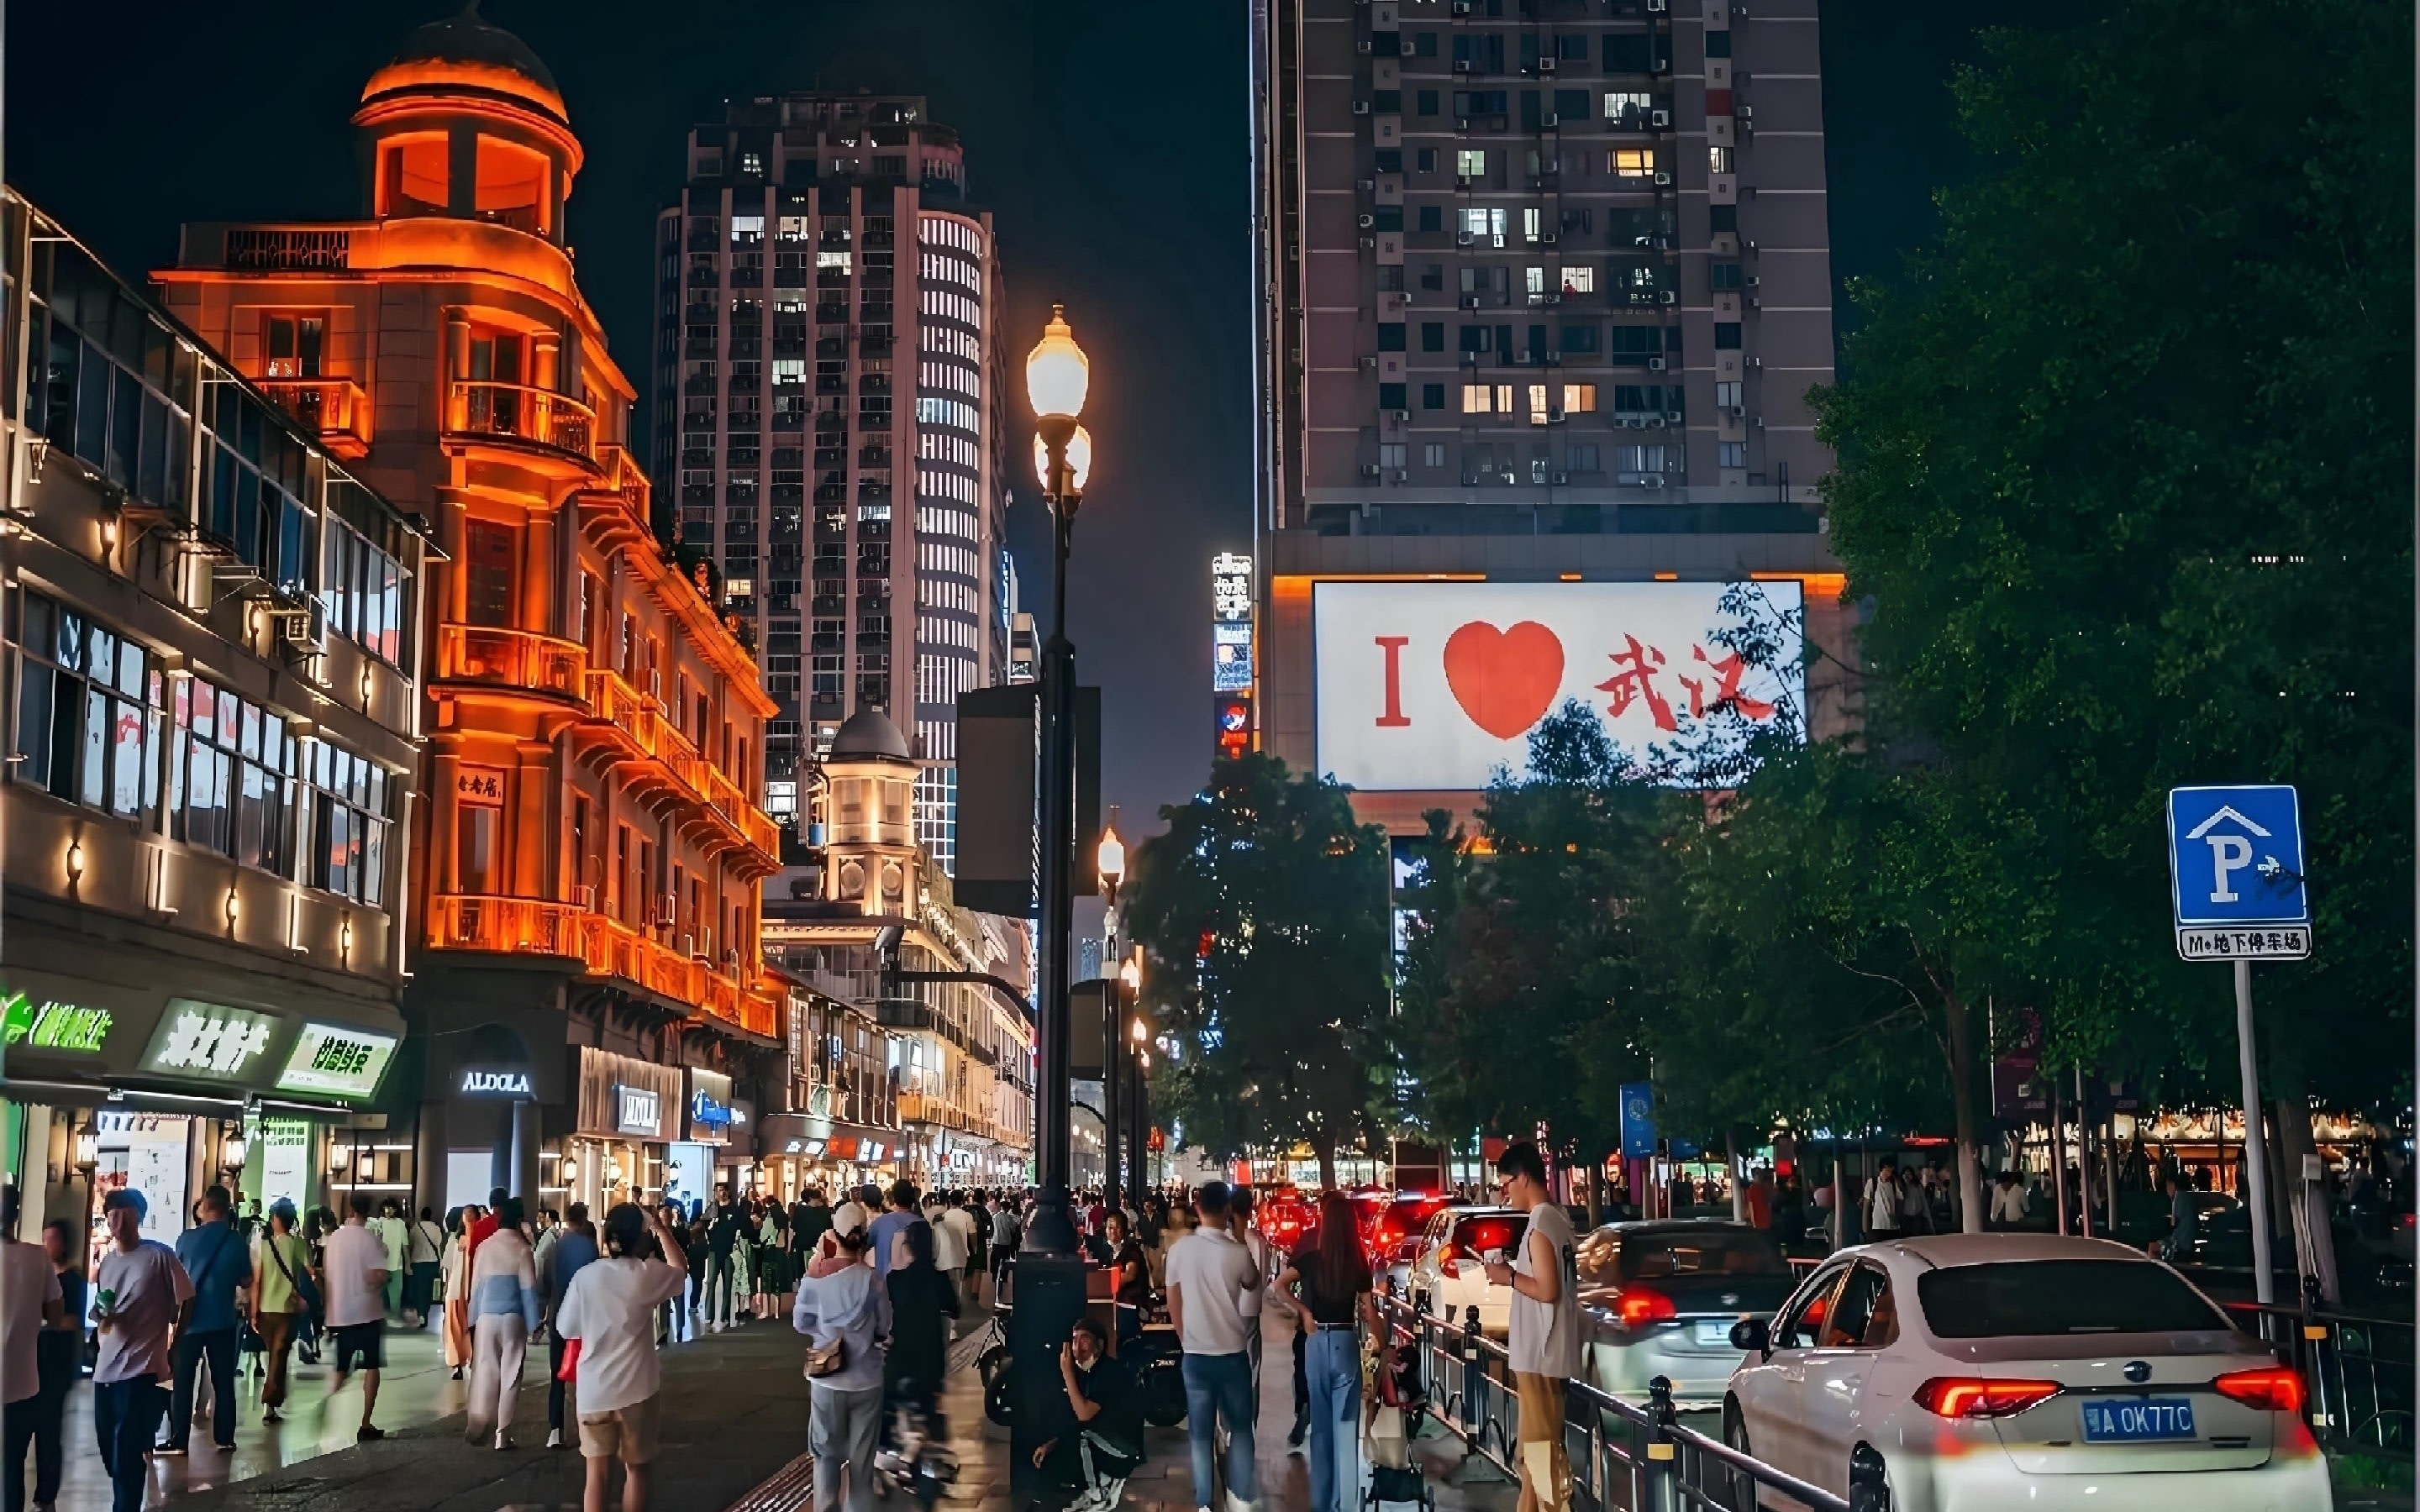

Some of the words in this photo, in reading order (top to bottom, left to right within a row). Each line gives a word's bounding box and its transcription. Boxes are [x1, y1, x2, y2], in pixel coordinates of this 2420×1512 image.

[1374, 635, 1412, 727] I
[1594, 632, 1776, 732] 武汉
[2206, 835, 2253, 903] P
